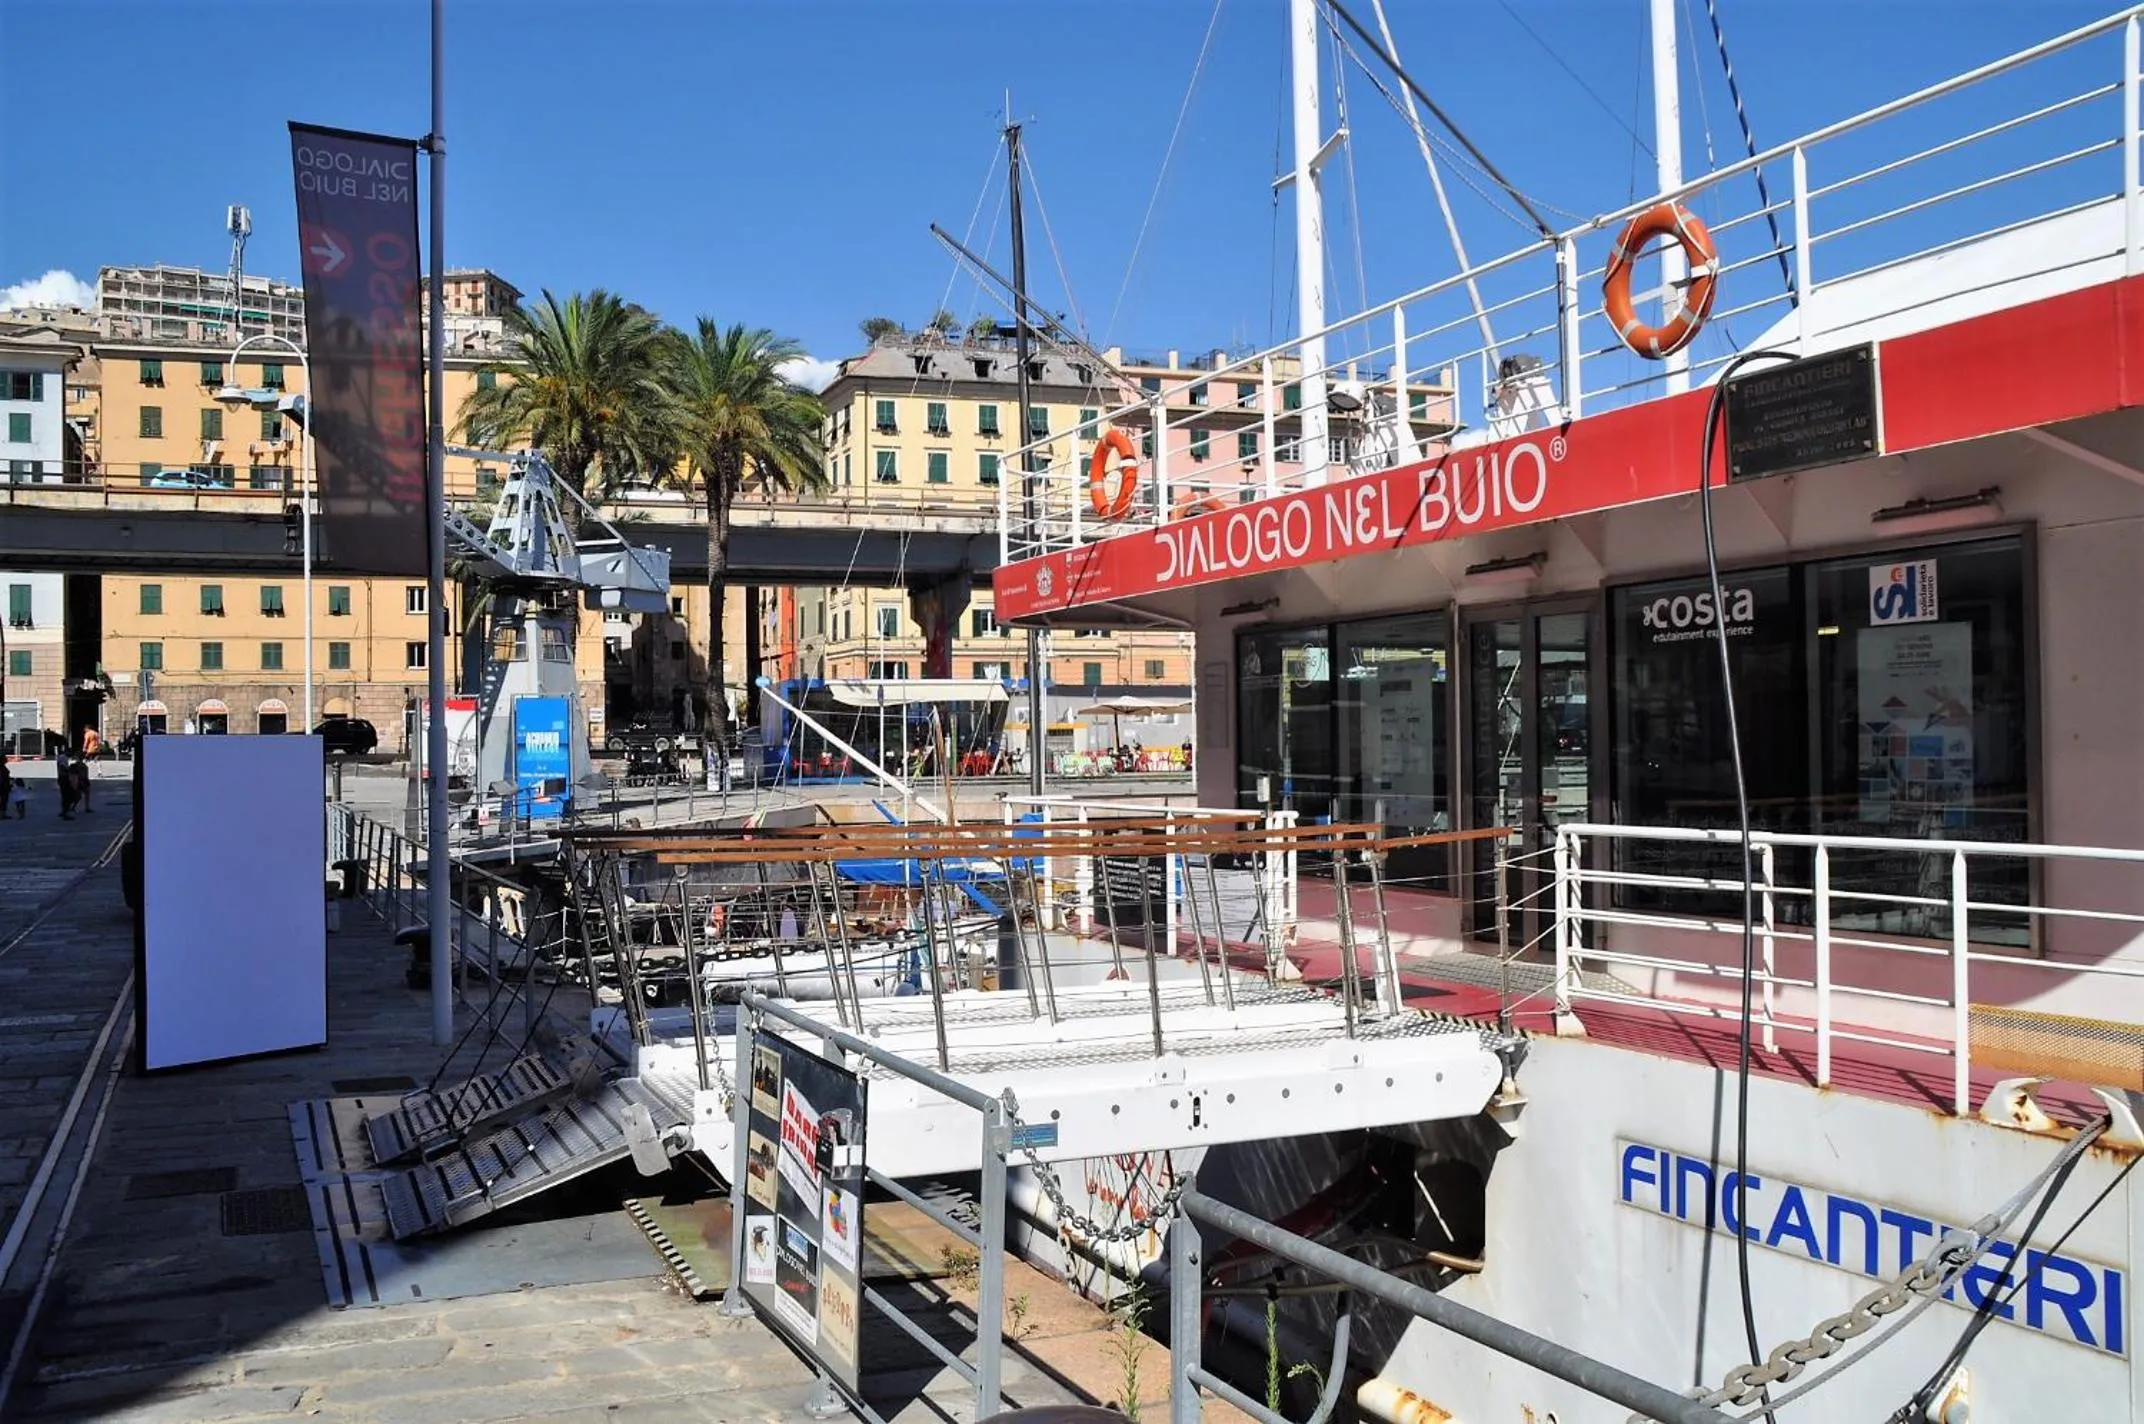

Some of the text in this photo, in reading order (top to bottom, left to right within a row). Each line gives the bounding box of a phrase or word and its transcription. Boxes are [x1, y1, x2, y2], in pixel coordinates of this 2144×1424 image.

[1743, 360, 1852, 399] FINCANTIERI
[1155, 499, 1312, 582] DIALOGO
[1324, 479, 1406, 551] NEL
[1706, 625, 1755, 640] exprience
